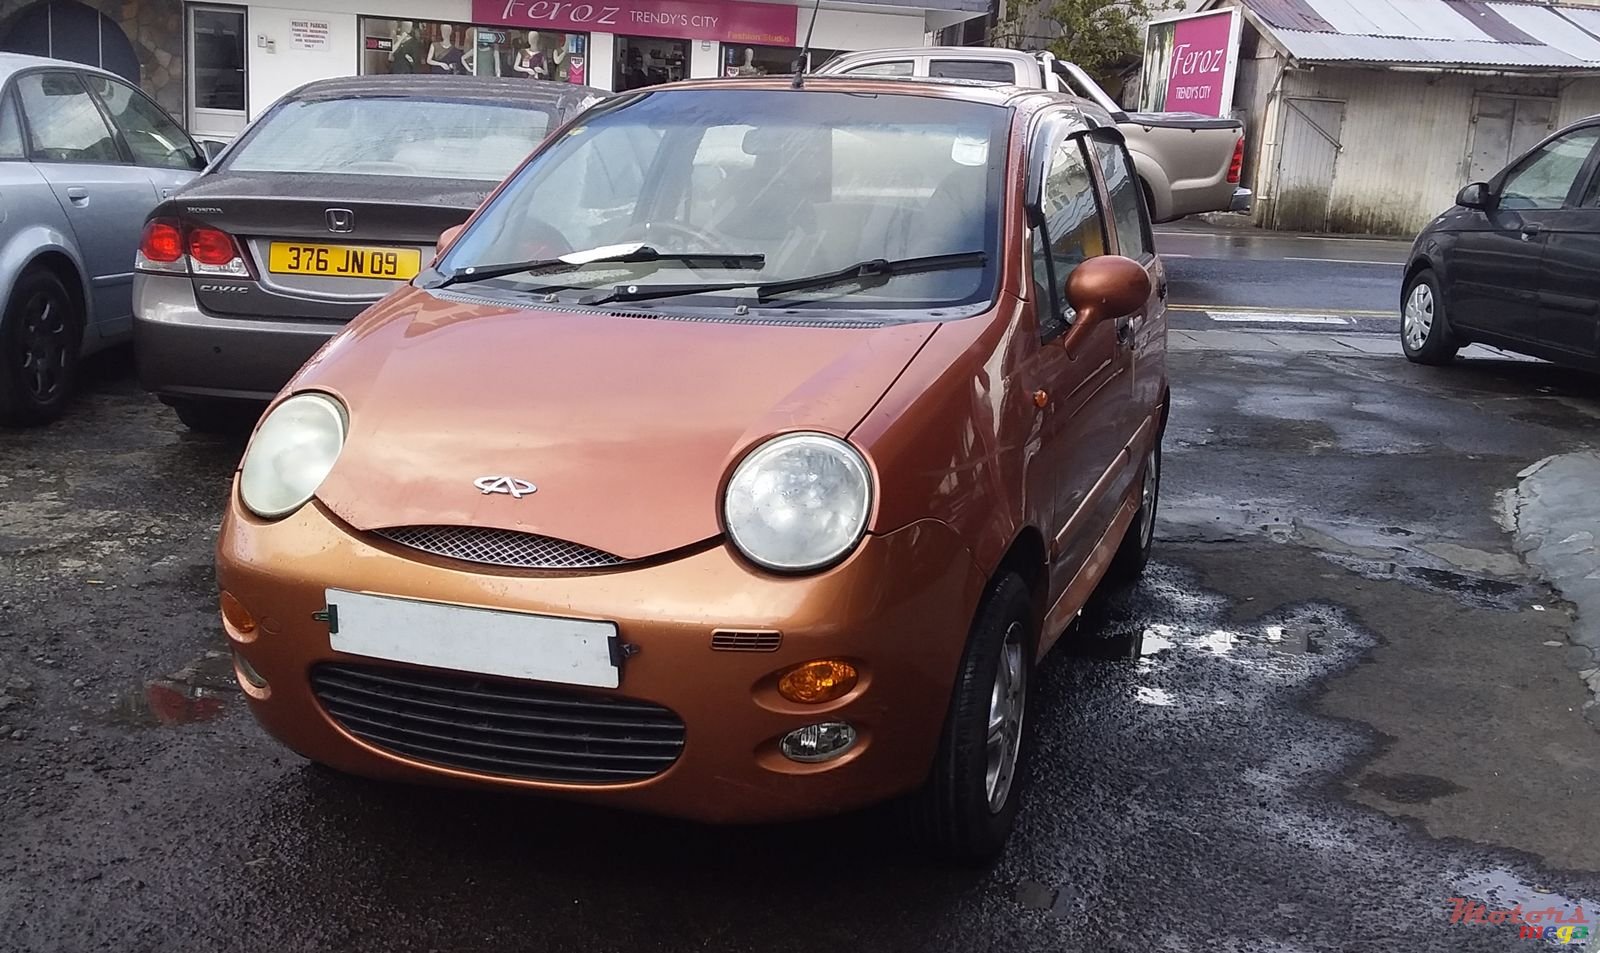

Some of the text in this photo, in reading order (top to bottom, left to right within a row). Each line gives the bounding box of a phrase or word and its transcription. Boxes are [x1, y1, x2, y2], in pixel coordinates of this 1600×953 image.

[502, 0, 719, 28] Feroz TRENDY'S CITY
[1172, 43, 1224, 80] Feroz
[1175, 85, 1212, 99] TRENDY'S CITY
[186, 206, 224, 214] HONDA
[287, 246, 398, 275] 376 JN 09
[199, 284, 250, 294] CIVIC
